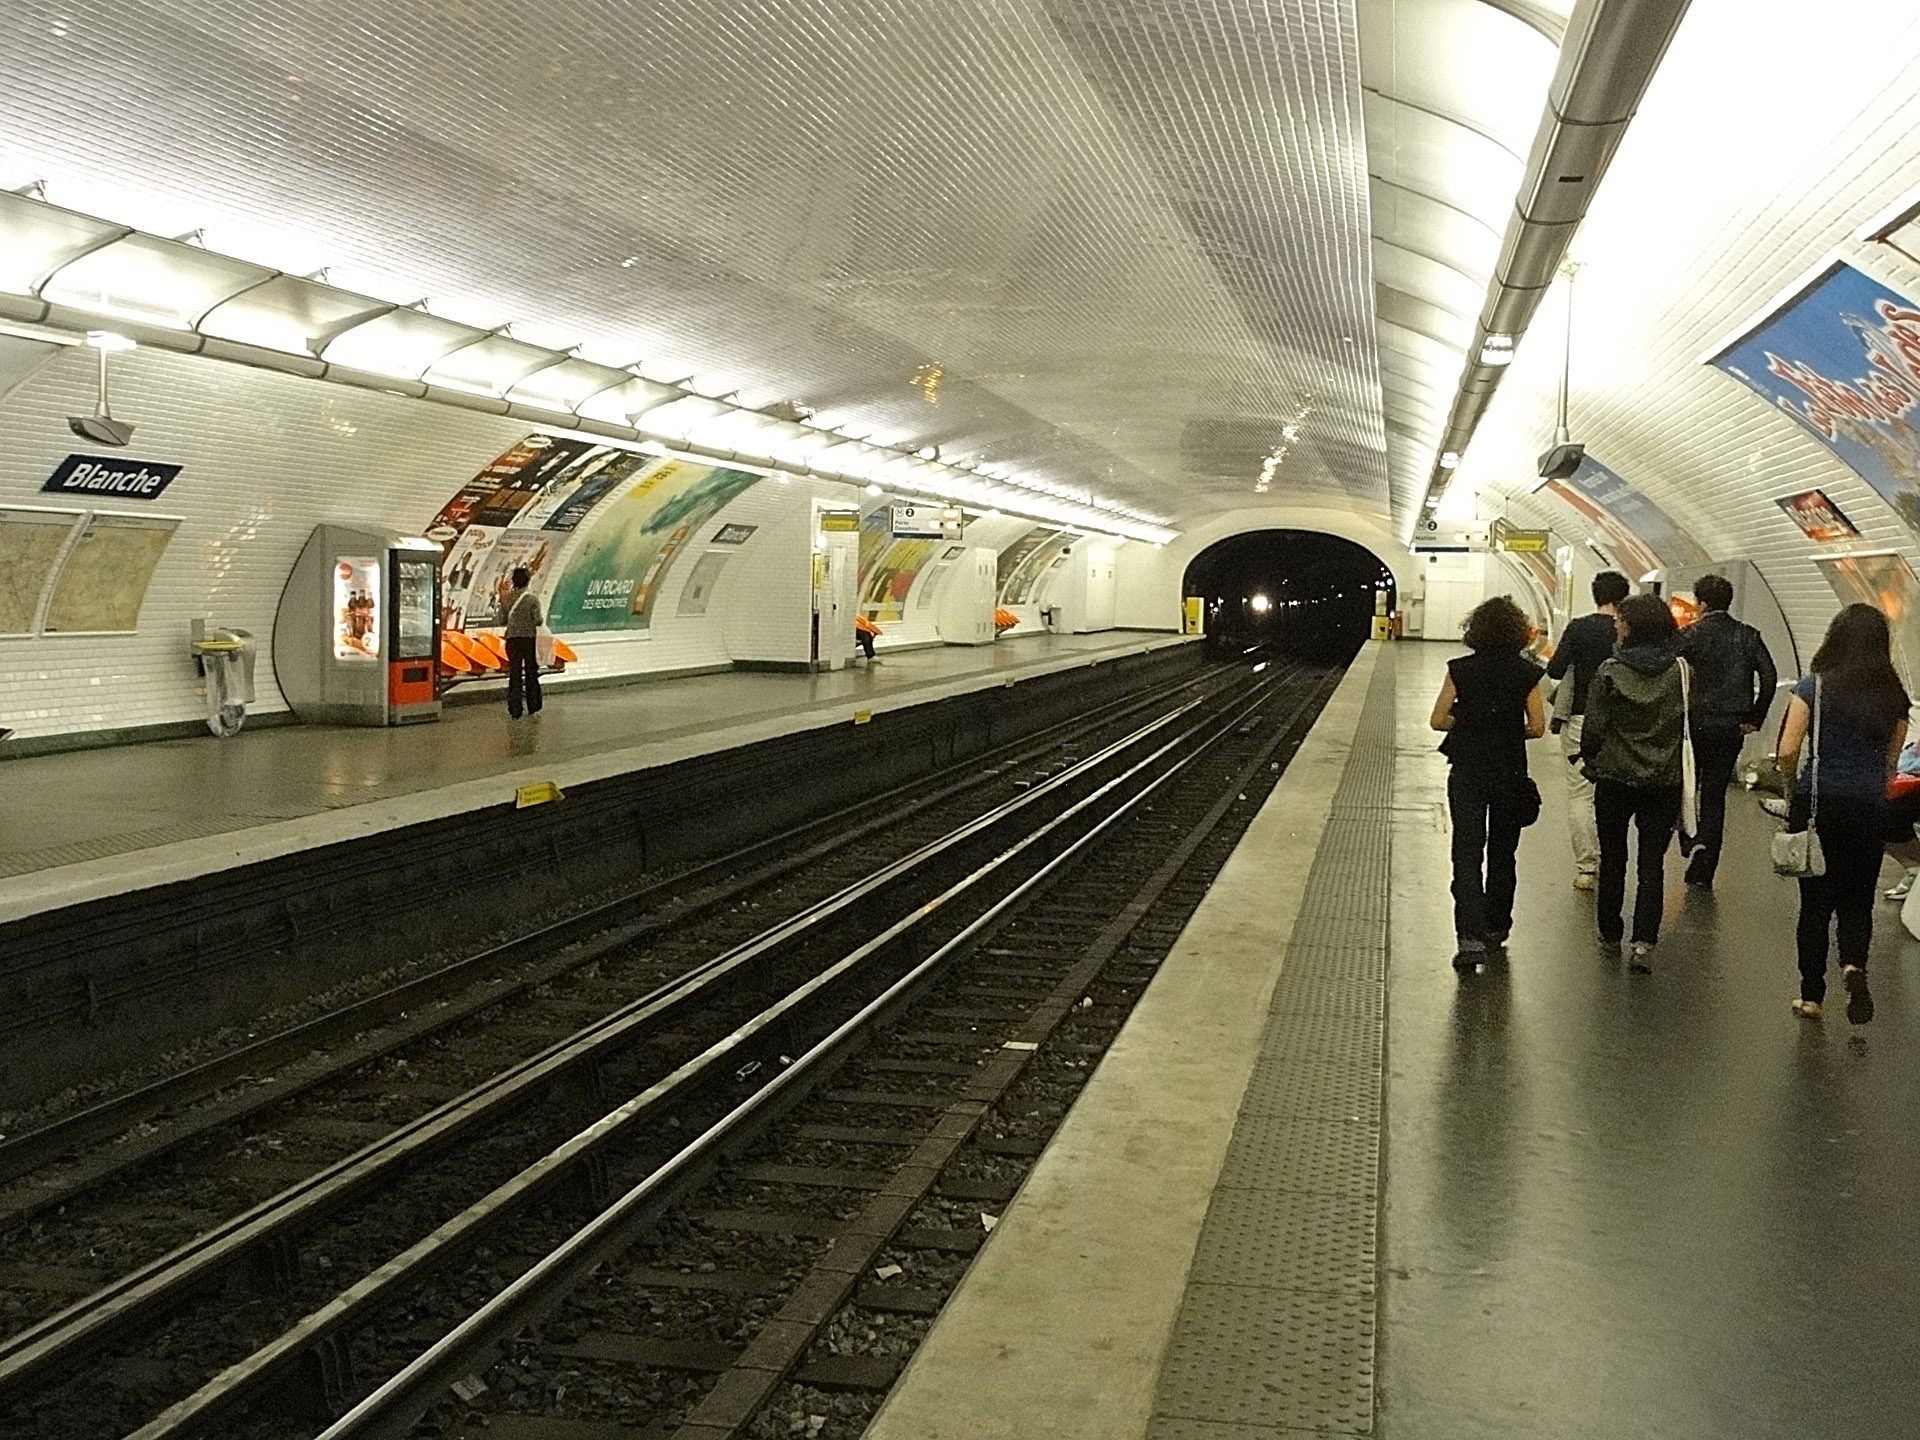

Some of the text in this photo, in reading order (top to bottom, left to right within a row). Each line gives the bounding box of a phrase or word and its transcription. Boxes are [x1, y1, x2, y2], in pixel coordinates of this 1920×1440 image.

[1855, 372, 1911, 416] des
[63, 463, 162, 493] Blanche
[1508, 540, 1536, 549] Alarme
[587, 579, 634, 595] UN RICARD
[582, 598, 595, 610] DES
